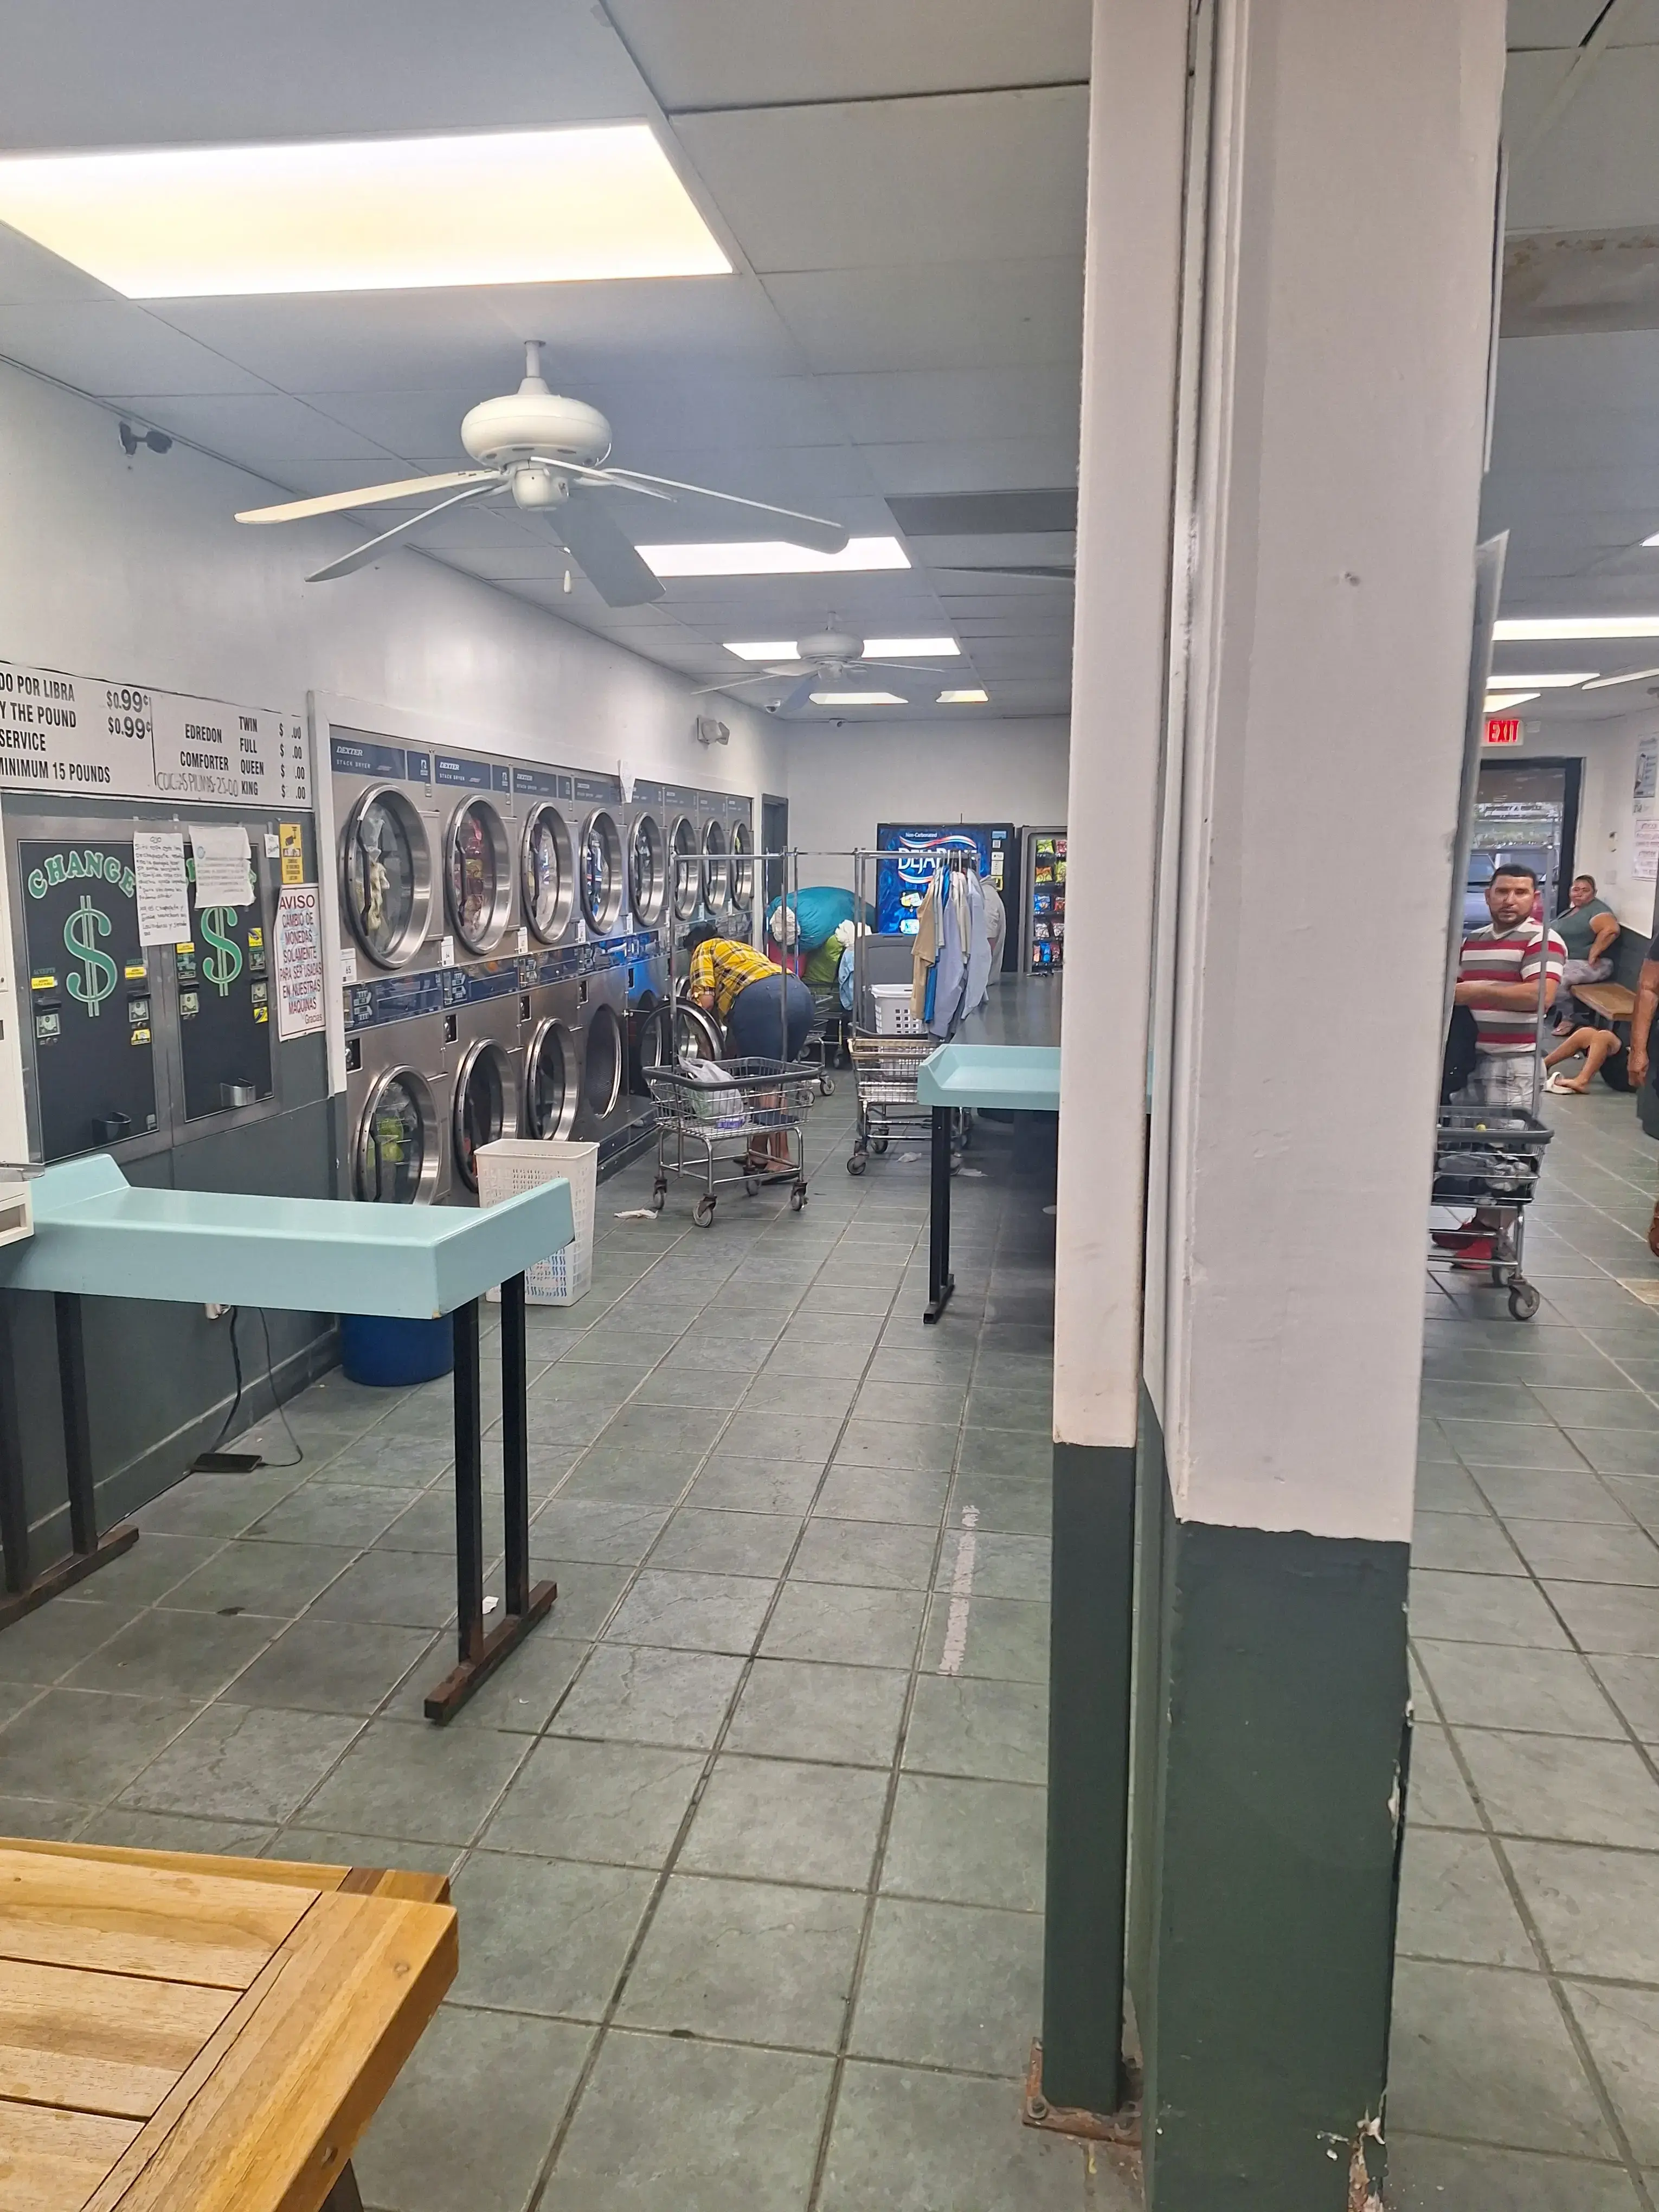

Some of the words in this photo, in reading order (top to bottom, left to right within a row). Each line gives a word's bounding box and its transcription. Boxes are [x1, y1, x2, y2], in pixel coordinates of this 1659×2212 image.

[17, 676, 41, 696] POR
[43, 679, 75, 702] LIBRA
[10, 702, 33, 723] THE
[37, 706, 76, 728] POUND
[239, 716, 258, 732] TWIN
[1489, 720, 1519, 742] EXIT
[0, 729, 46, 751] SERVICE
[185, 724, 222, 743] EDREDON
[240, 738, 258, 754] FULL
[336, 746, 363, 756] DEXTER
[180, 751, 229, 771] COMFORTER
[241, 759, 265, 775] QUEEN
[440, 761, 459, 770] DEXTER
[53, 762, 65, 780] 15
[69, 763, 111, 783] POUNDS
[241, 781, 258, 795] KING
[28, 850, 136, 899] CHANGE
[279, 895, 315, 910] AVISO
[282, 913, 303, 928] CAMBIO
[306, 912, 313, 925] DE
[285, 930, 312, 945] MONEDAS
[284, 946, 317, 963] SOLAMENTE
[280, 967, 291, 982] PARA
[293, 964, 303, 979] SER
[304, 962, 321, 977] USADAS
[283, 985, 291, 999] EN
[293, 979, 321, 996] NUESTRAS
[288, 997, 317, 1015] MAQUINAS
[305, 1012, 321, 1024] Gracias
